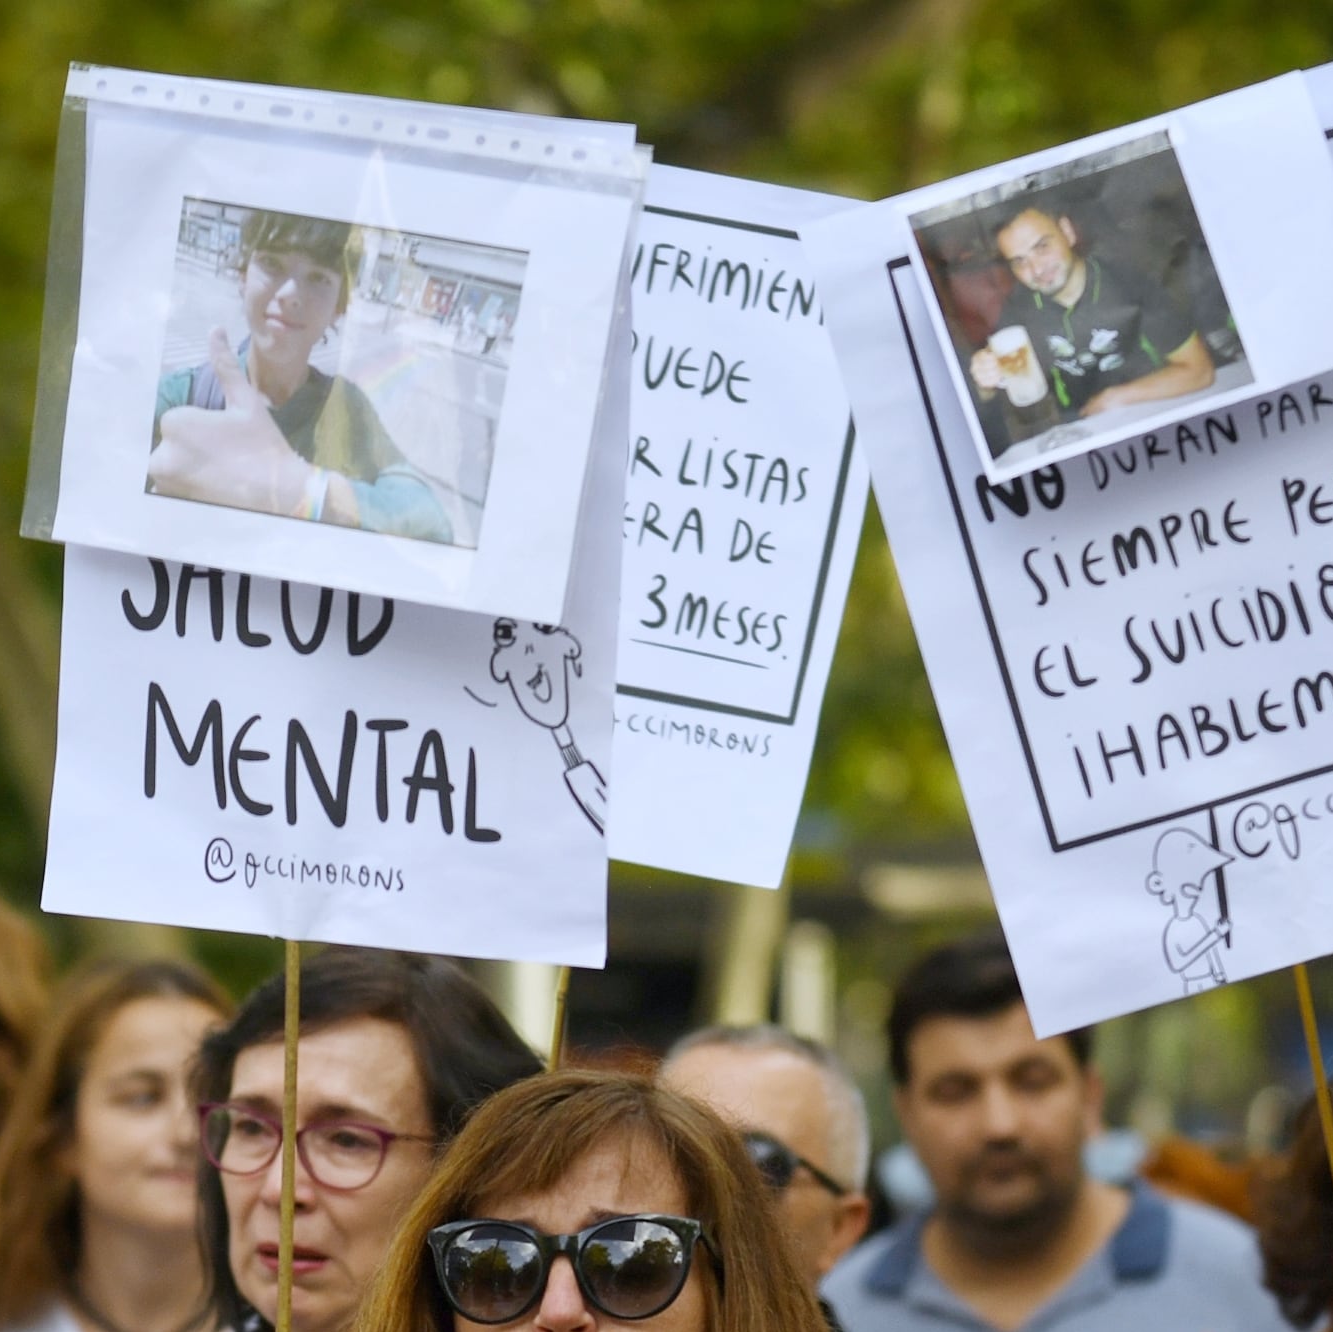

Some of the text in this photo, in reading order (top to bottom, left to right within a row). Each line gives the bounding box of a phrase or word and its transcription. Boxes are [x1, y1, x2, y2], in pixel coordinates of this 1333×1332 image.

[631, 244, 824, 326] FRIMIEN
[632, 329, 751, 403] UEDE
[678, 437, 809, 505] LISTAS
[975, 463, 1066, 523] NO
[1087, 413, 1239, 491] DURAN
[728, 517, 777, 563] DE
[1022, 500, 1252, 606] SIEMPRE
[122, 557, 395, 656] SALUD
[1033, 643, 1098, 698] EL
[144, 681, 501, 843] MENTAL
[612, 712, 772, 757] CCIMORONS
